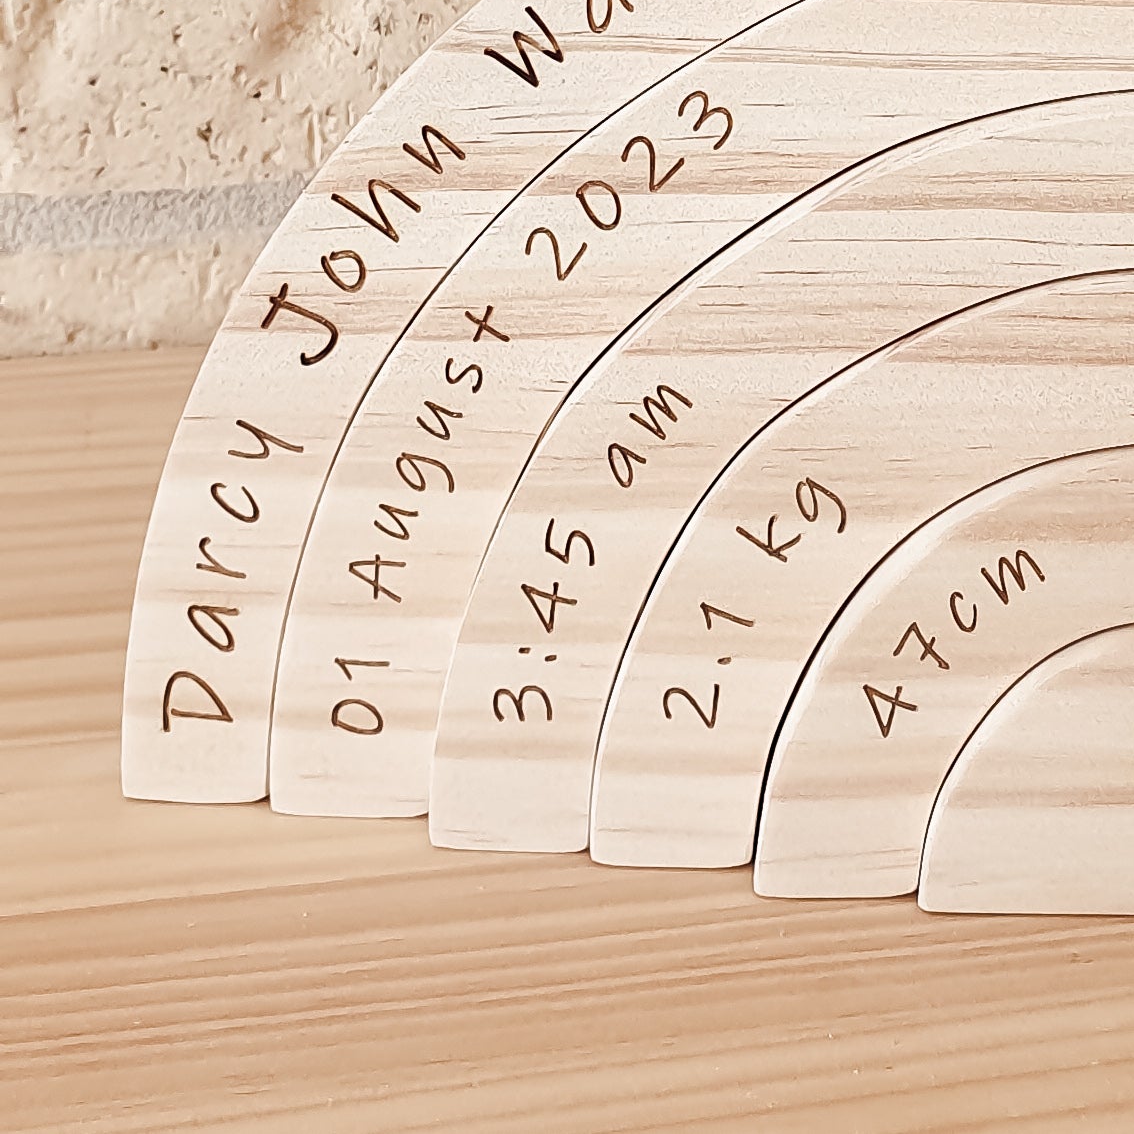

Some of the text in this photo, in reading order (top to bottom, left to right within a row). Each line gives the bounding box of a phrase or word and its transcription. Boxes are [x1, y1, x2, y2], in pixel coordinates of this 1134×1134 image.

[161, 418, 305, 733] Darcy
[261, 124, 466, 366] John
[330, 90, 734, 737] 01 August 2023
[492, 384, 692, 722] 3:45 am
[662, 476, 847, 729] 2.1 kg
[863, 548, 1046, 738] 47cm
